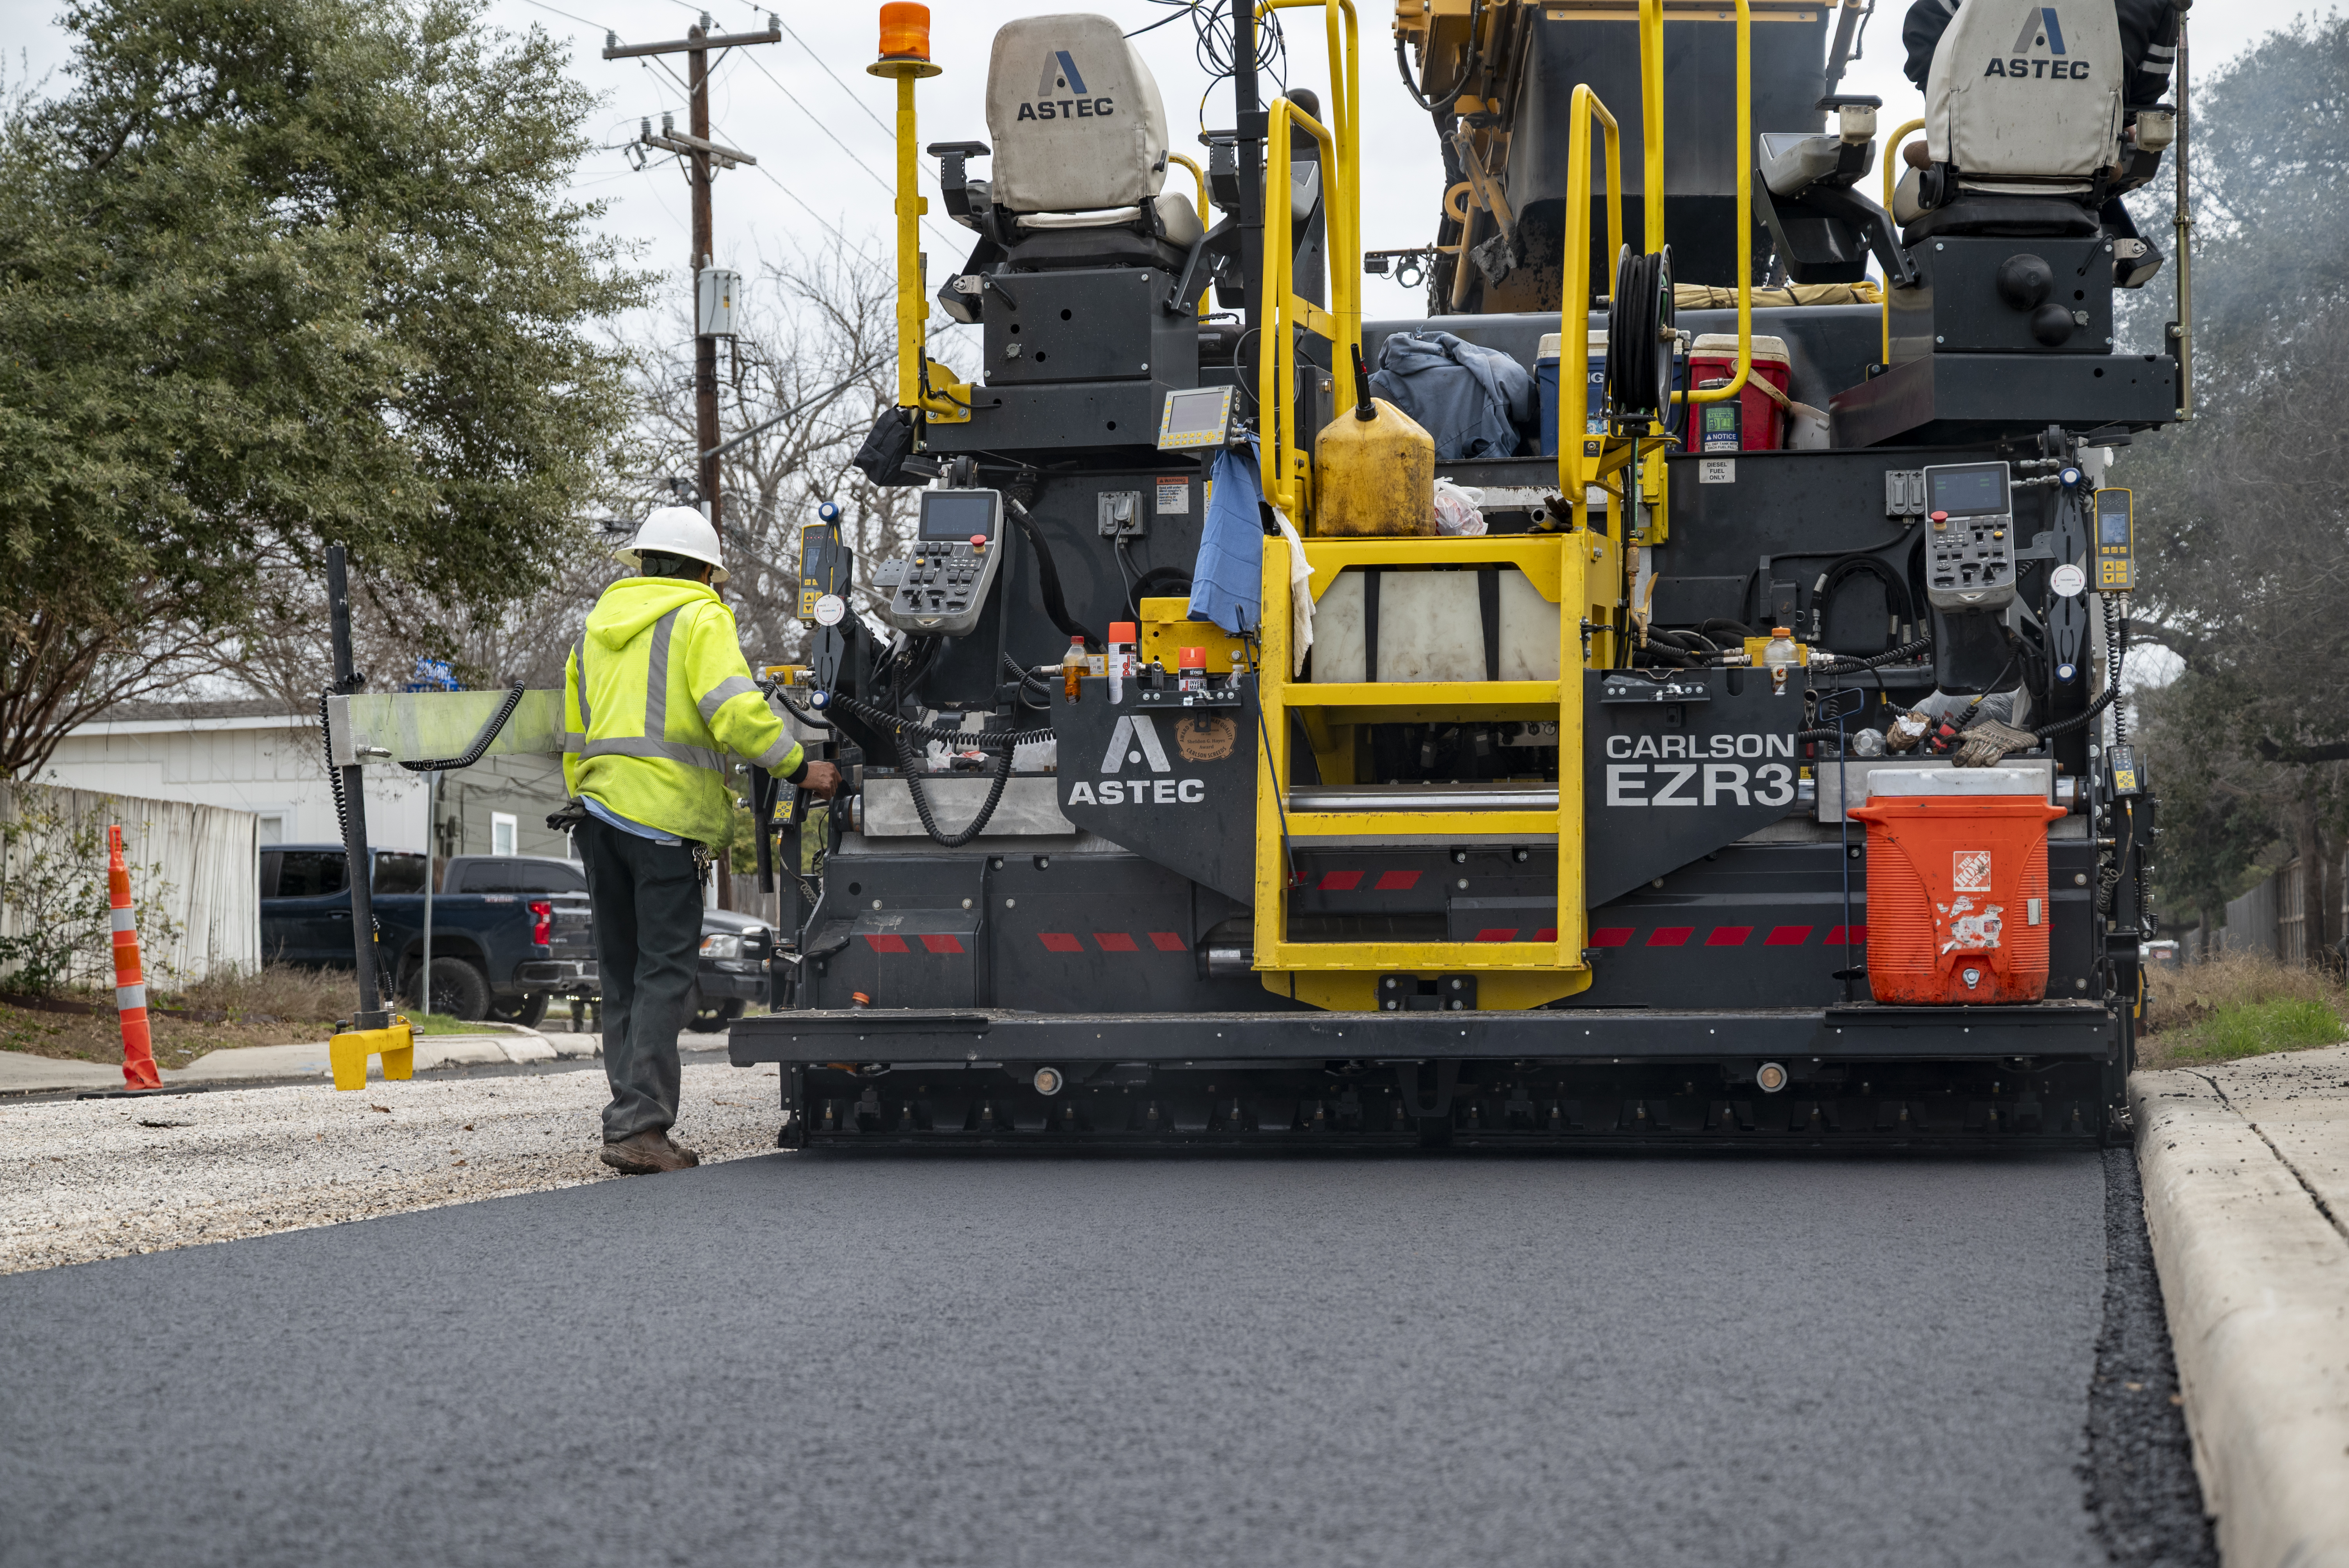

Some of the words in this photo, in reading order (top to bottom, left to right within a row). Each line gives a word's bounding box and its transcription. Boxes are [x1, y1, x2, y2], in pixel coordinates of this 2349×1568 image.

[1984, 57, 2090, 79] ASTEC
[1017, 97, 1114, 121] ASTEC
[1180, 725, 1190, 742] AWARD
[1220, 722, 1233, 741] QUALITY
[1186, 748, 1207, 758] CARLSON
[1208, 746, 1227, 758] SCREEDS
[1606, 734, 1795, 759] CARLSON
[1068, 779, 1205, 805] ASTEC
[1606, 763, 1795, 806] EZR3
[1955, 852, 1990, 887] HOME
[1957, 855, 1973, 870] THE
[1968, 864, 1990, 887] DEPOT
